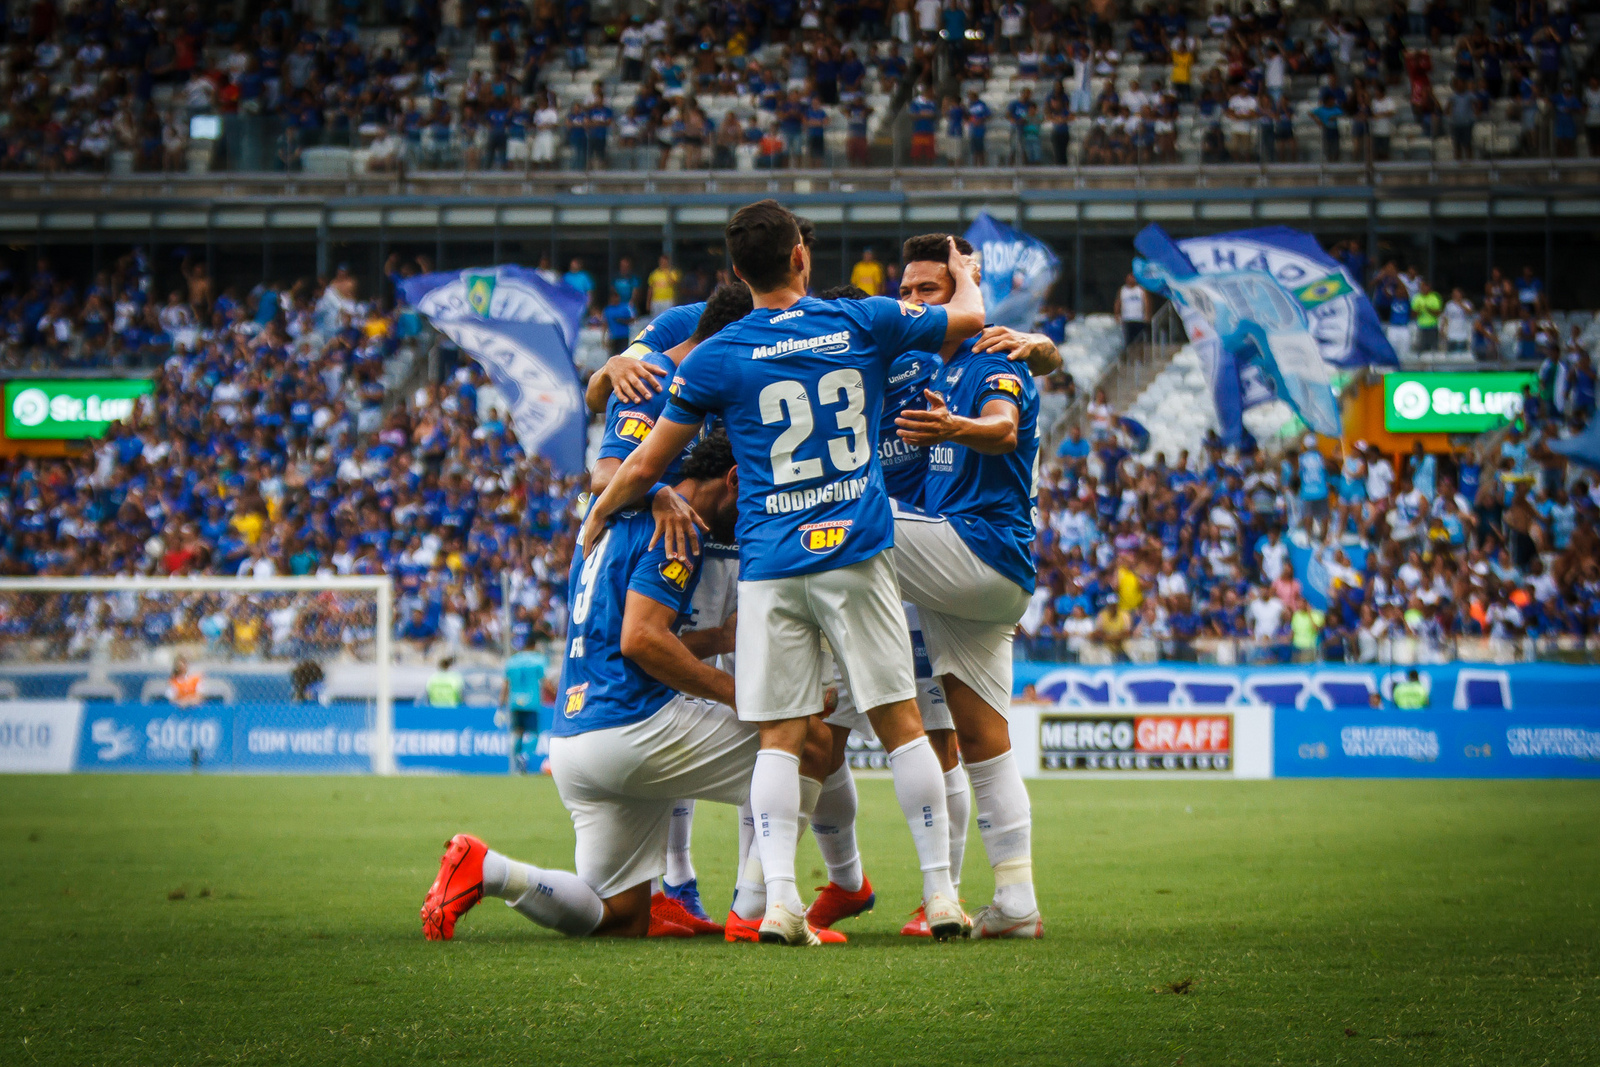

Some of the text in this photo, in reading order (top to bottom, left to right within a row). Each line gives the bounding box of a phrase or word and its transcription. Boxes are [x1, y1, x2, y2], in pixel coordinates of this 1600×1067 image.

[769, 310, 804, 324] umbro
[752, 331, 850, 360] Multimarcas
[619, 418, 652, 442] BH
[759, 368, 870, 485] 23
[798, 520, 853, 532] SUPERMERCADOS
[809, 528, 846, 550] BH
[662, 560, 690, 589] BH
[566, 691, 585, 713] BH
[146, 715, 217, 749] SÓCIO
[248, 730, 286, 754] COM
[289, 725, 336, 754] VOCÊ
[338, 731, 351, 754] O
[460, 727, 472, 755] É
[474, 731, 510, 755] MAI
[1041, 719, 1228, 750] MERCO GRAFF
[1341, 726, 1420, 741] CRUZEIRO
[1507, 728, 1586, 741] CRUZEIRO
[1343, 740, 1439, 760] VANTAGENS
